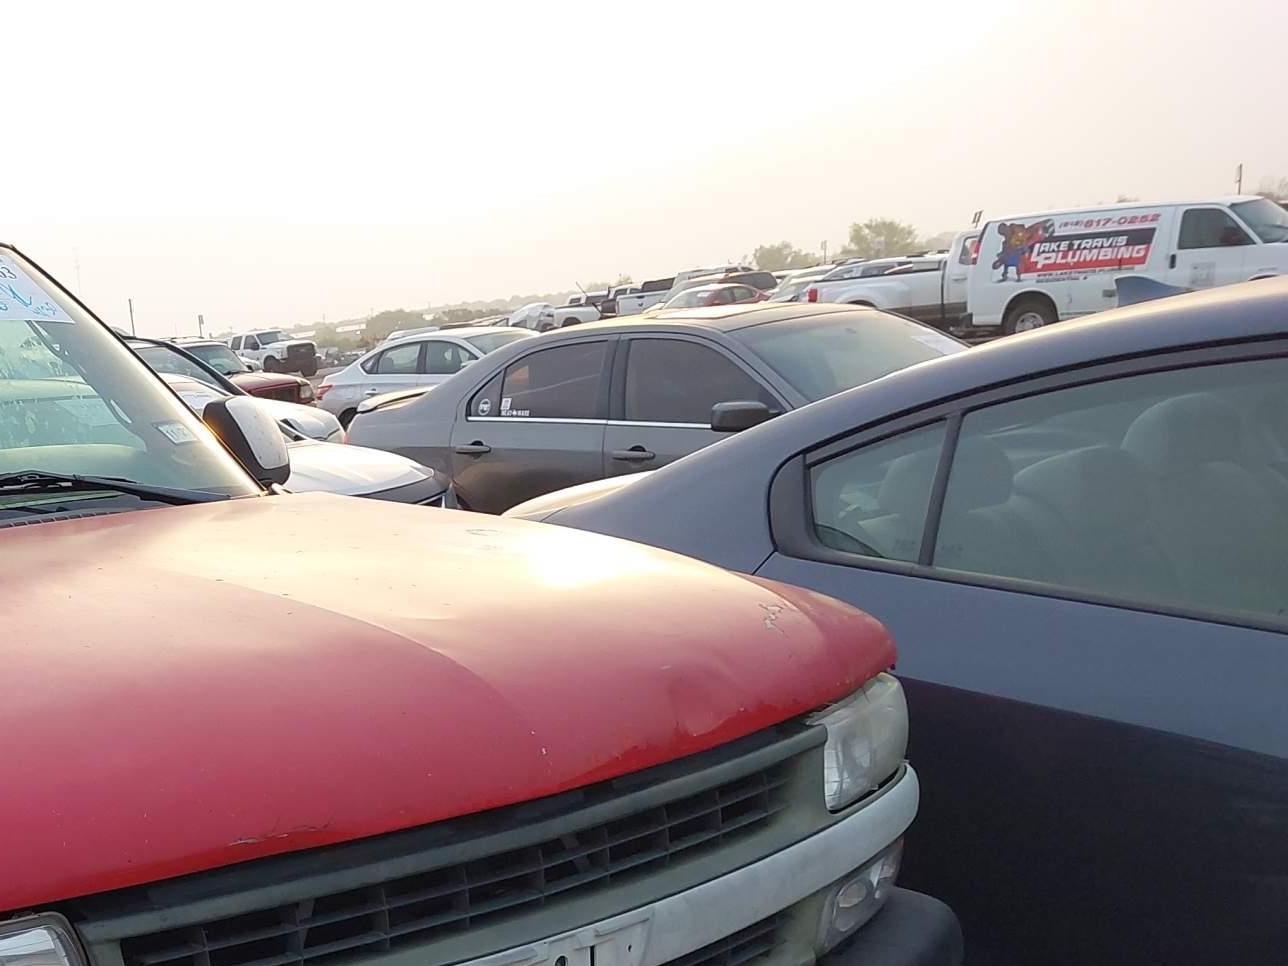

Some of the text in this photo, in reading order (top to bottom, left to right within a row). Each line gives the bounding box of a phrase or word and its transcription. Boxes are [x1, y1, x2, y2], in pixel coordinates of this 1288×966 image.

[1031, 236, 1128, 263] LAKE TRAVIS
[1036, 245, 1147, 269] PLUMBING
